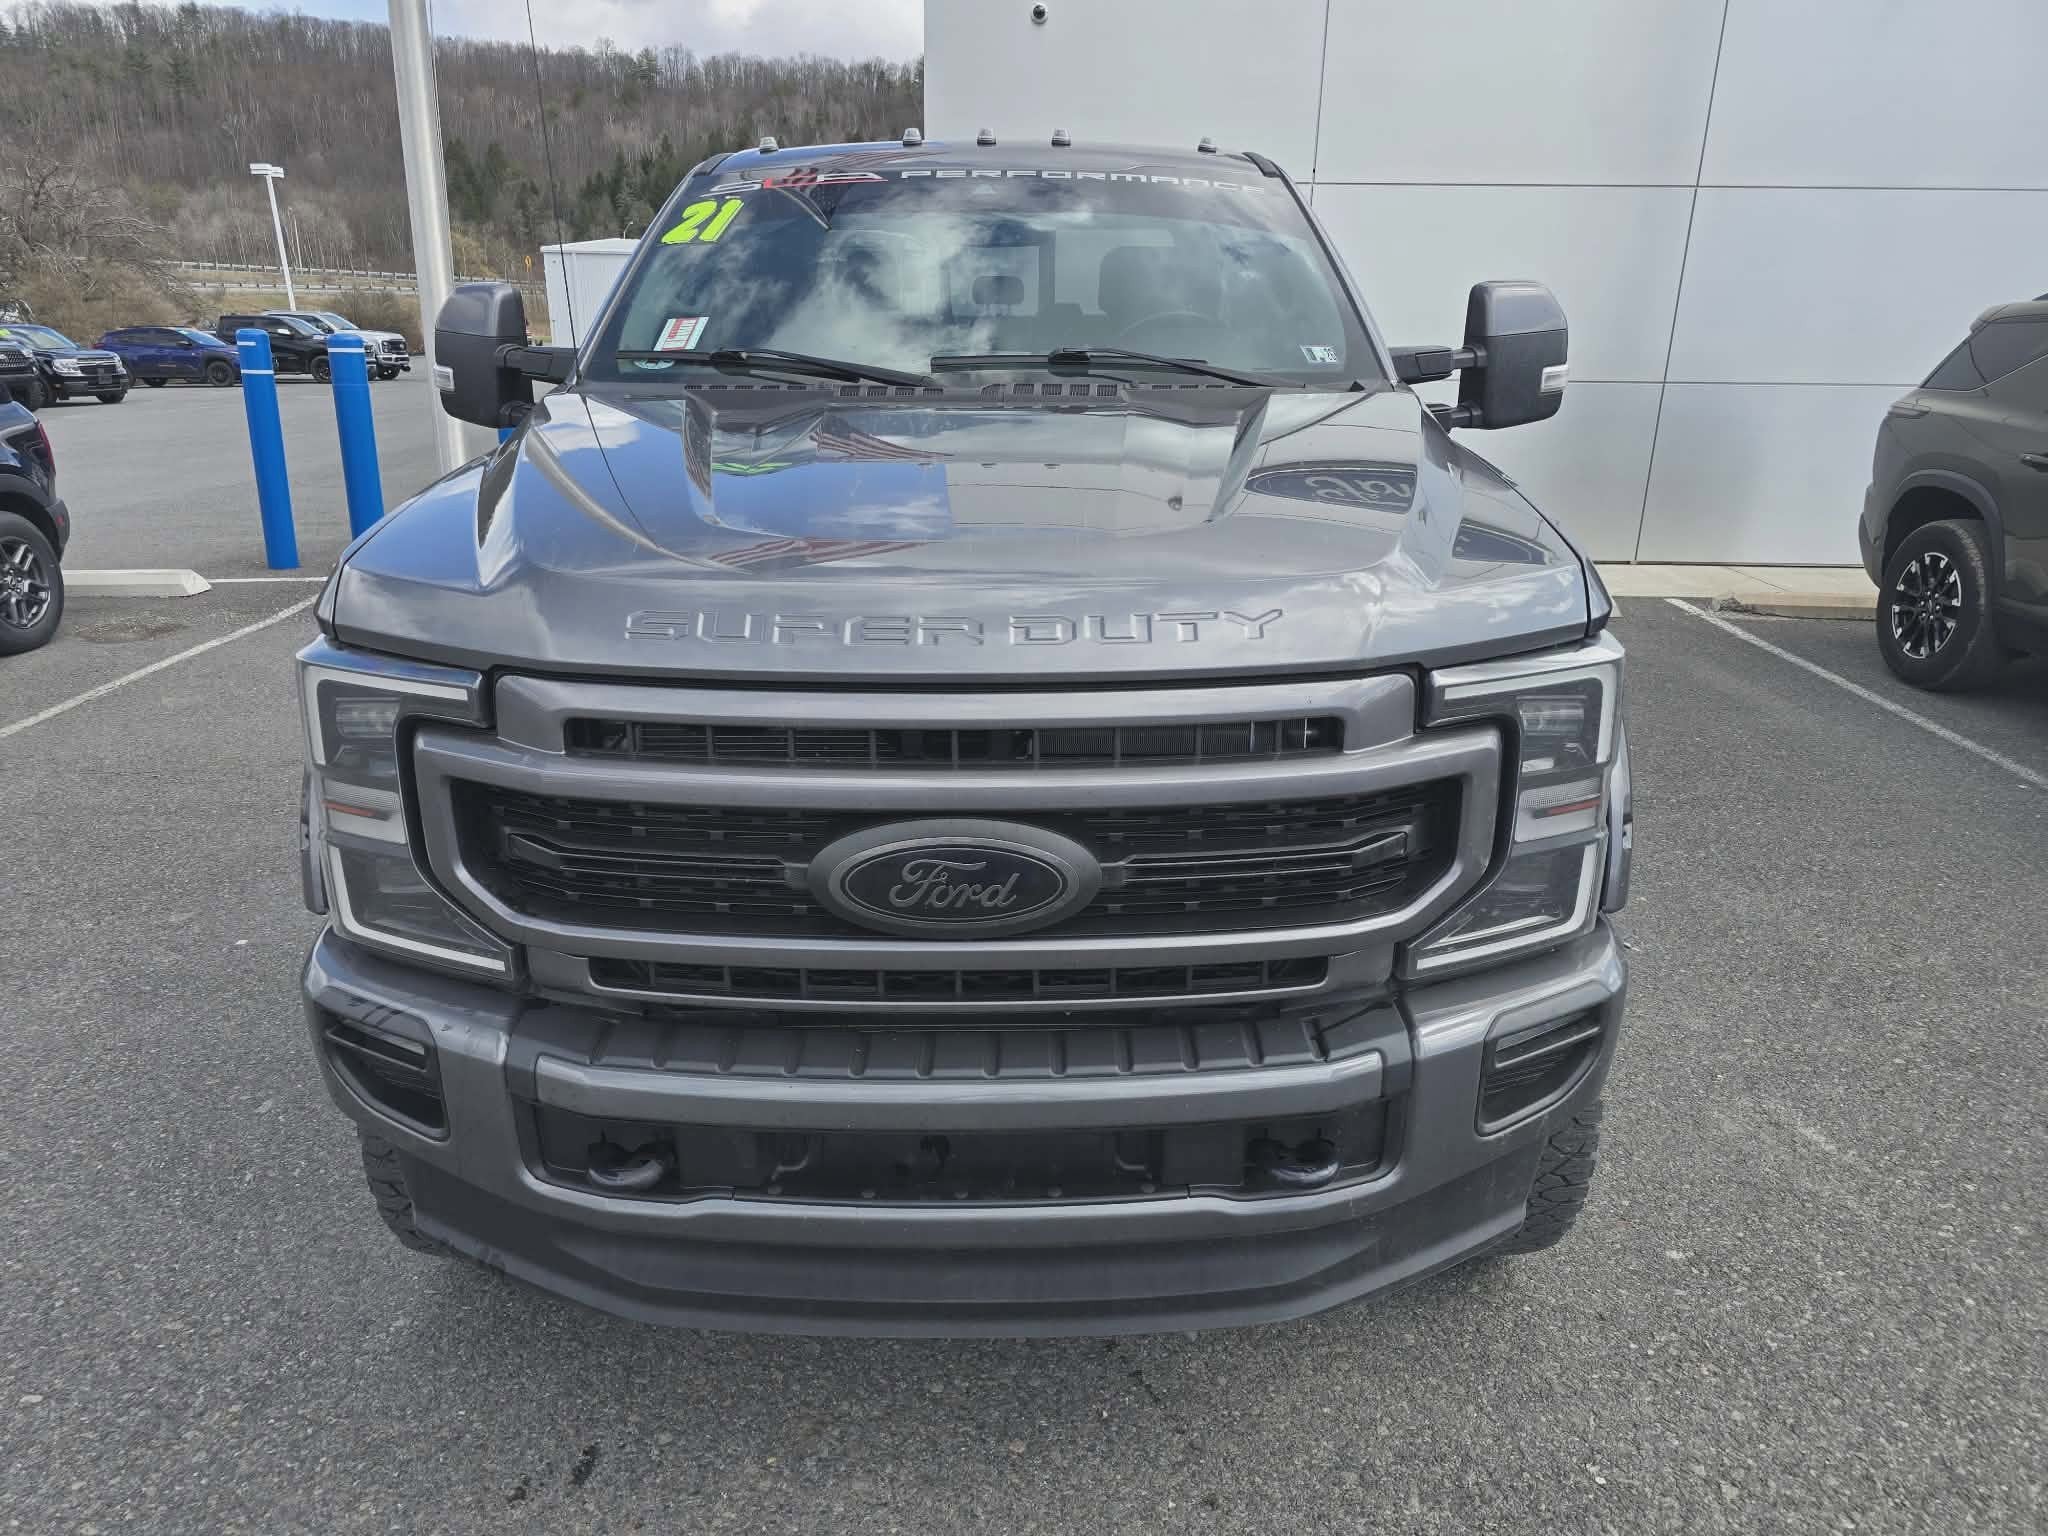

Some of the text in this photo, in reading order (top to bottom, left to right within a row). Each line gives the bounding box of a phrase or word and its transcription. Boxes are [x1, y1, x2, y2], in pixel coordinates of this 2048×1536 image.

[901, 170, 1265, 193] PERFORMANCE
[661, 197, 744, 244] 21
[625, 608, 1284, 646] SUPER DUTY
[889, 859, 1020, 908] Ford
